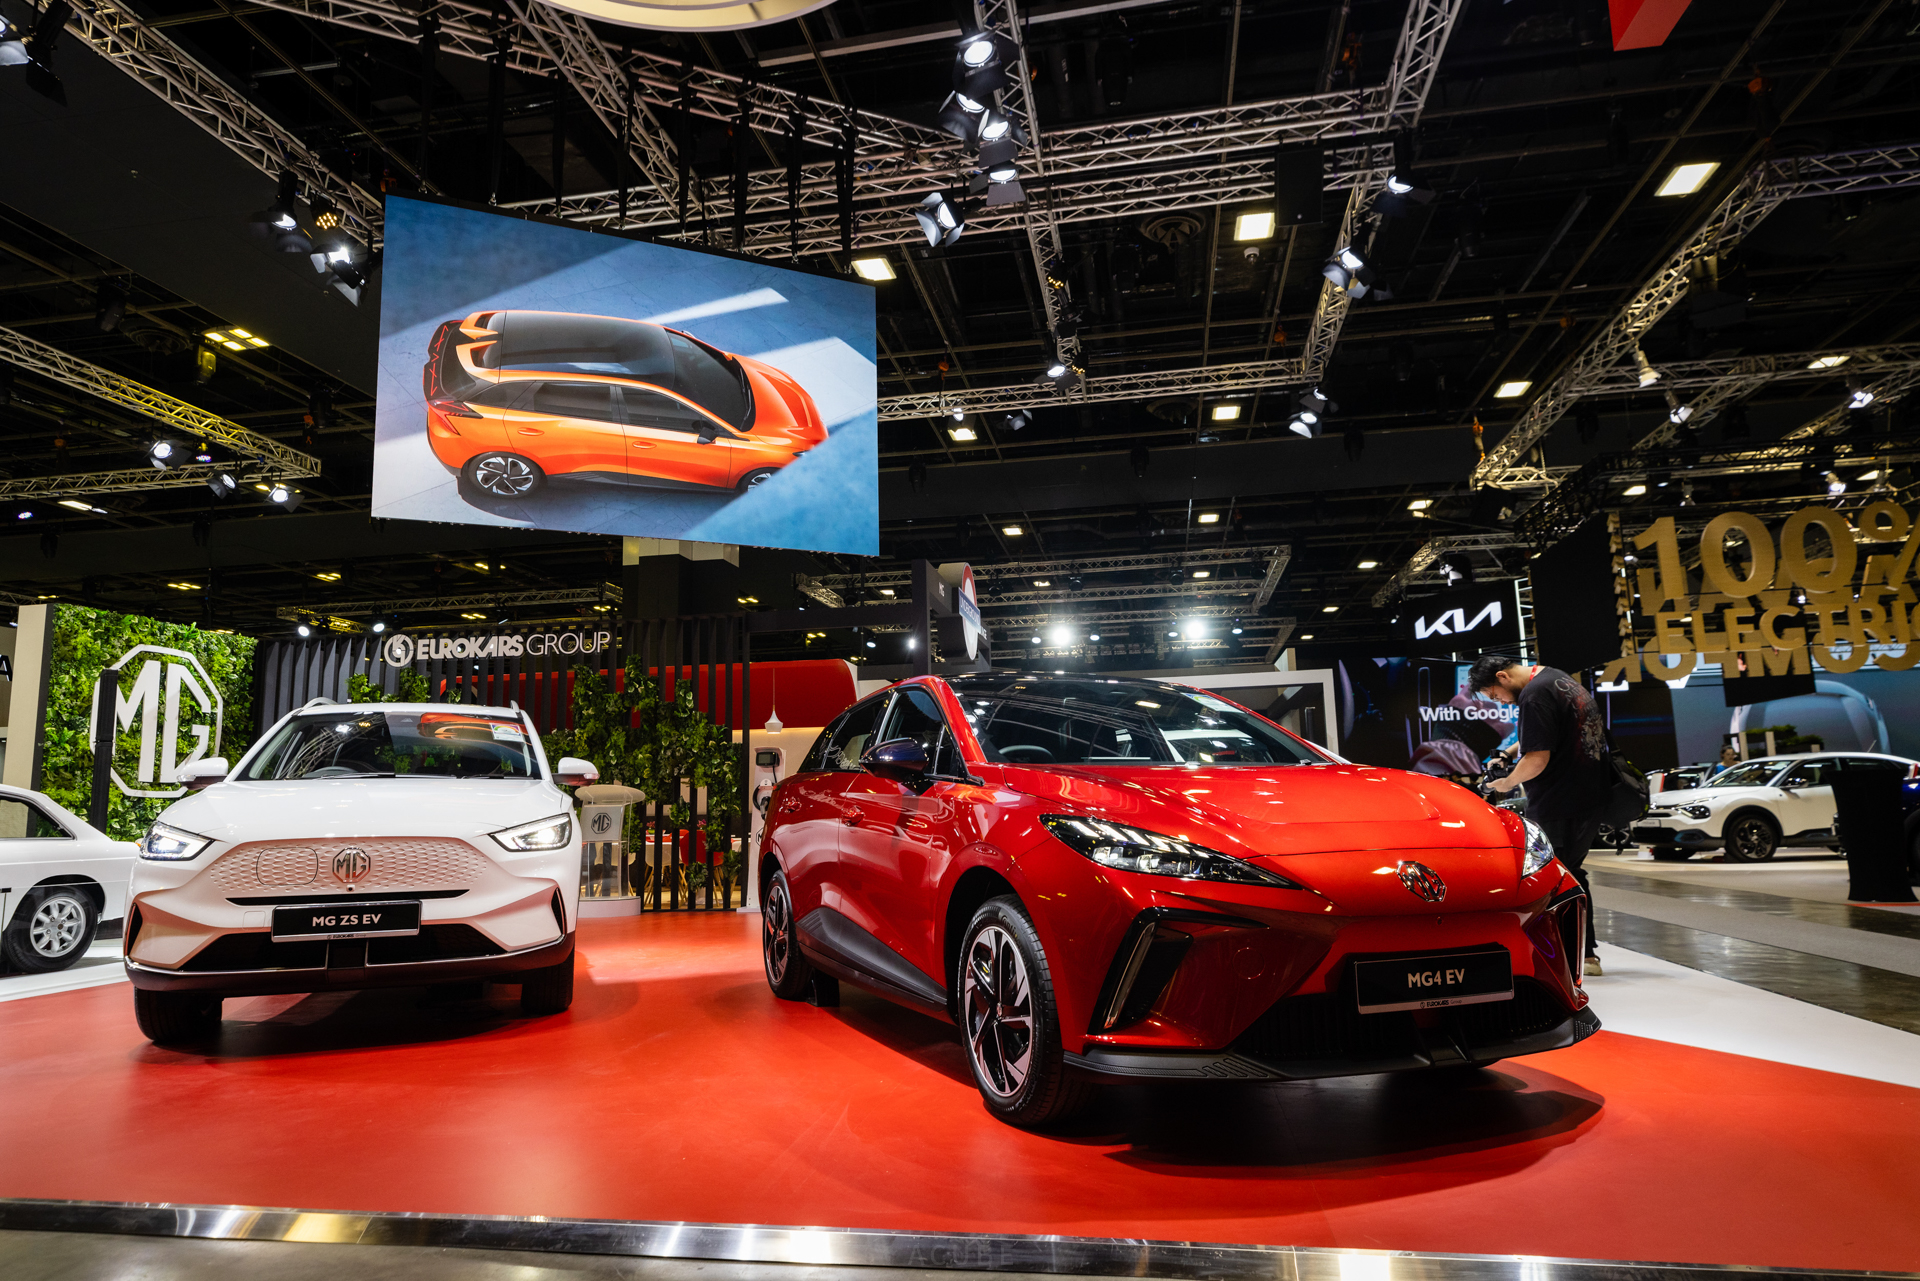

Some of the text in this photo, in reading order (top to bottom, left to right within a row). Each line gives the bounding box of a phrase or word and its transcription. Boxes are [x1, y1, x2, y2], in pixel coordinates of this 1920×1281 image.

[1655, 600, 1920, 655] ELECTRI
[417, 631, 611, 660] EUROKARS GROUP
[112, 659, 212, 784] MG
[1419, 706, 1460, 722] With
[592, 814, 610, 832] MG
[336, 850, 367, 880] MG
[312, 914, 382, 927] MG ZS EV
[1407, 968, 1465, 988] MG4 EV
